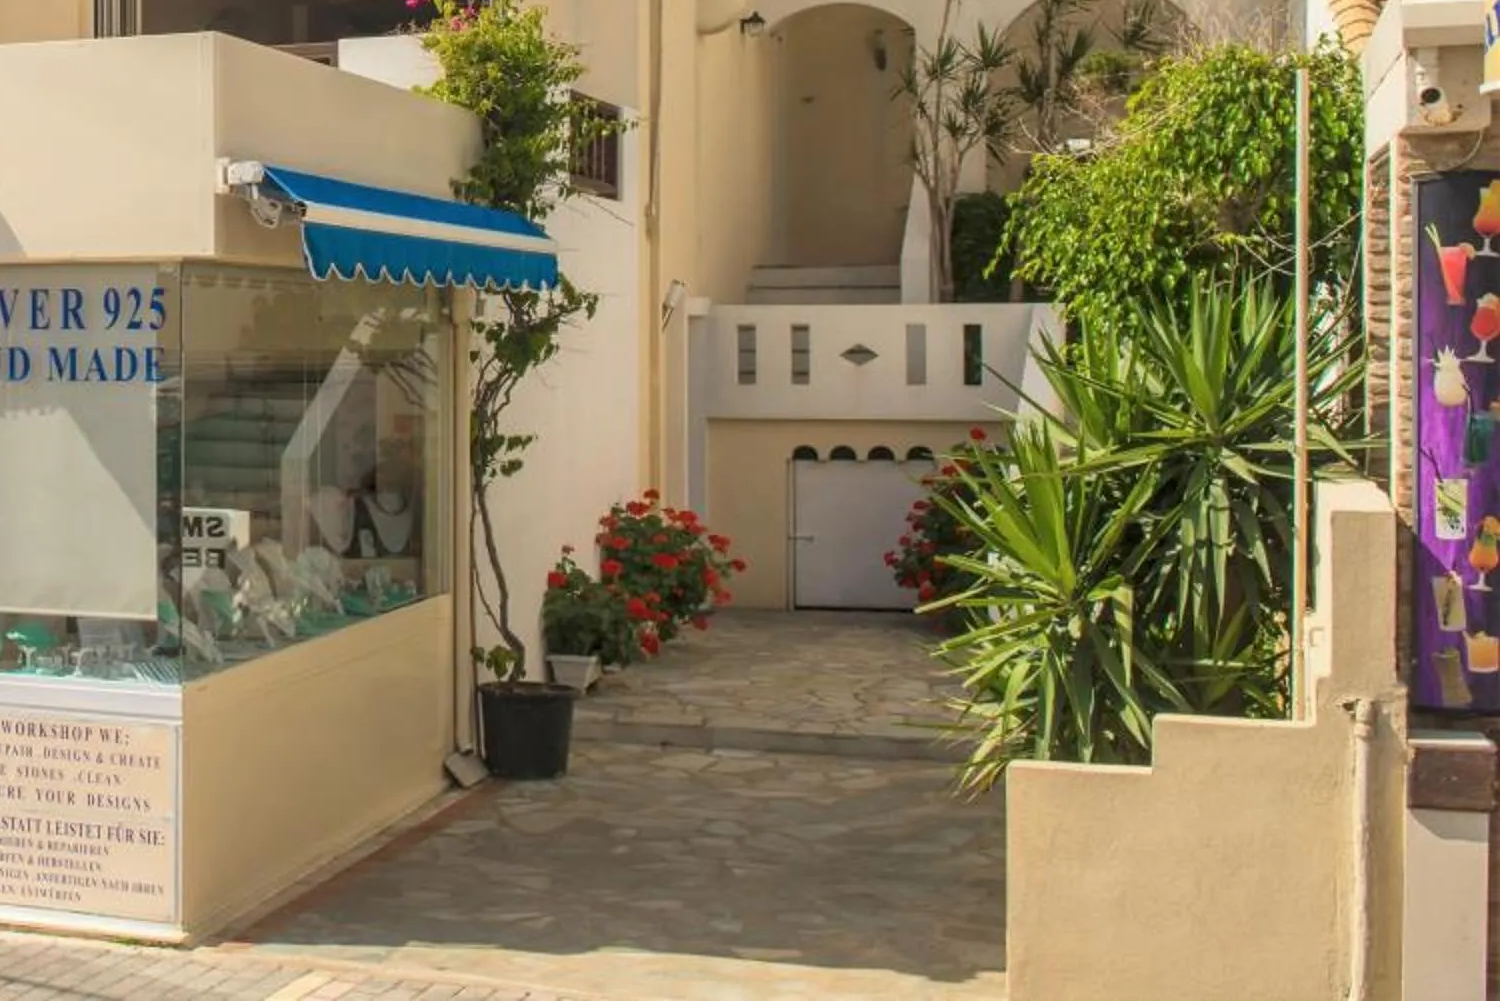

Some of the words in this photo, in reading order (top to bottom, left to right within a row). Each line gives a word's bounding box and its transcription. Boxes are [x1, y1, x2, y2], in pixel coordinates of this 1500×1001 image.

[102, 287, 167, 331] 925
[47, 346, 166, 382] MADE
[0, 719, 93, 742] WORKSHOP
[95, 751, 103, 764] &
[109, 753, 160, 769] CREATE
[16, 765, 64, 781] STONES
[35, 787, 76, 806] YOUR
[86, 792, 152, 813] DESIGNS
[46, 820, 102, 839] LEISTET
